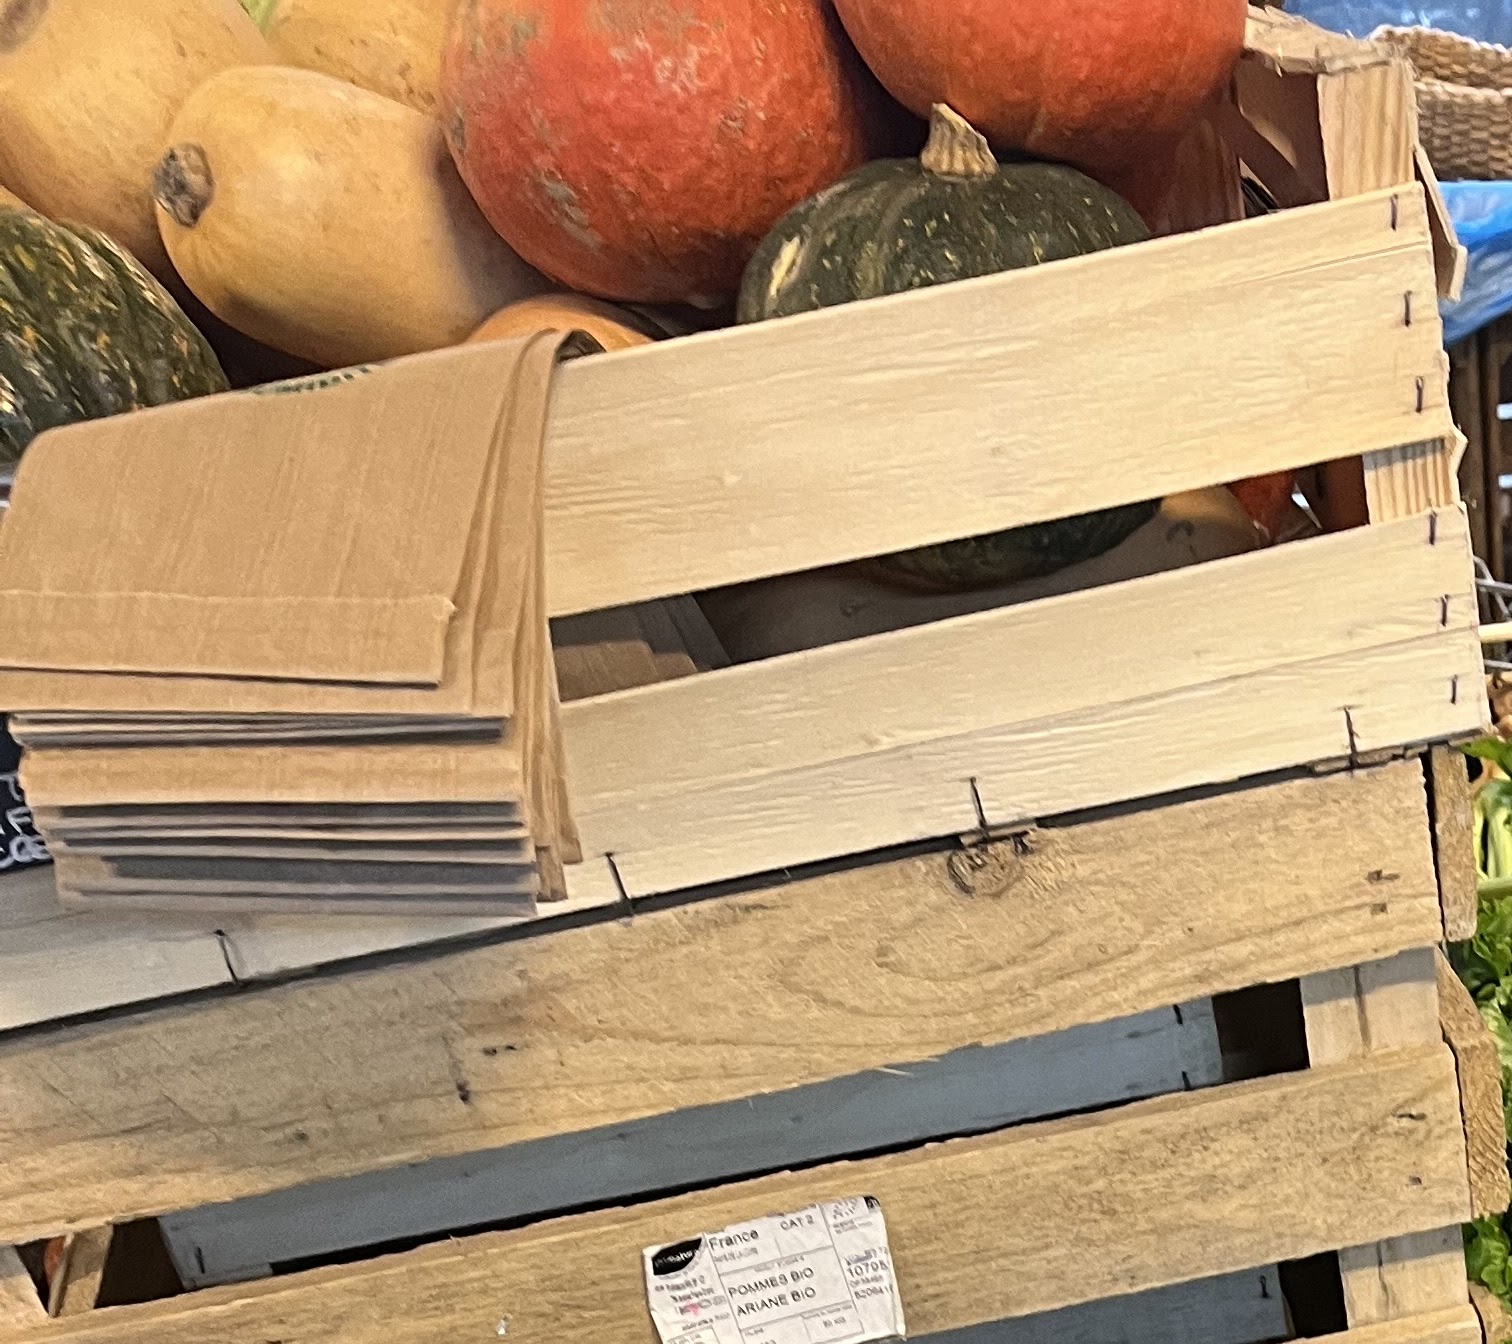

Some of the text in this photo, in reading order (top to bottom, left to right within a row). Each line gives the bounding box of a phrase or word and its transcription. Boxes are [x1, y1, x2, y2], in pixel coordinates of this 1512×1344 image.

[709, 1230, 759, 1251] France
[780, 1215, 805, 1231] CAT
[728, 1267, 814, 1298] POMMES BIO
[736, 1294, 790, 1317] ARIANE
[790, 1286, 816, 1303] BIO
